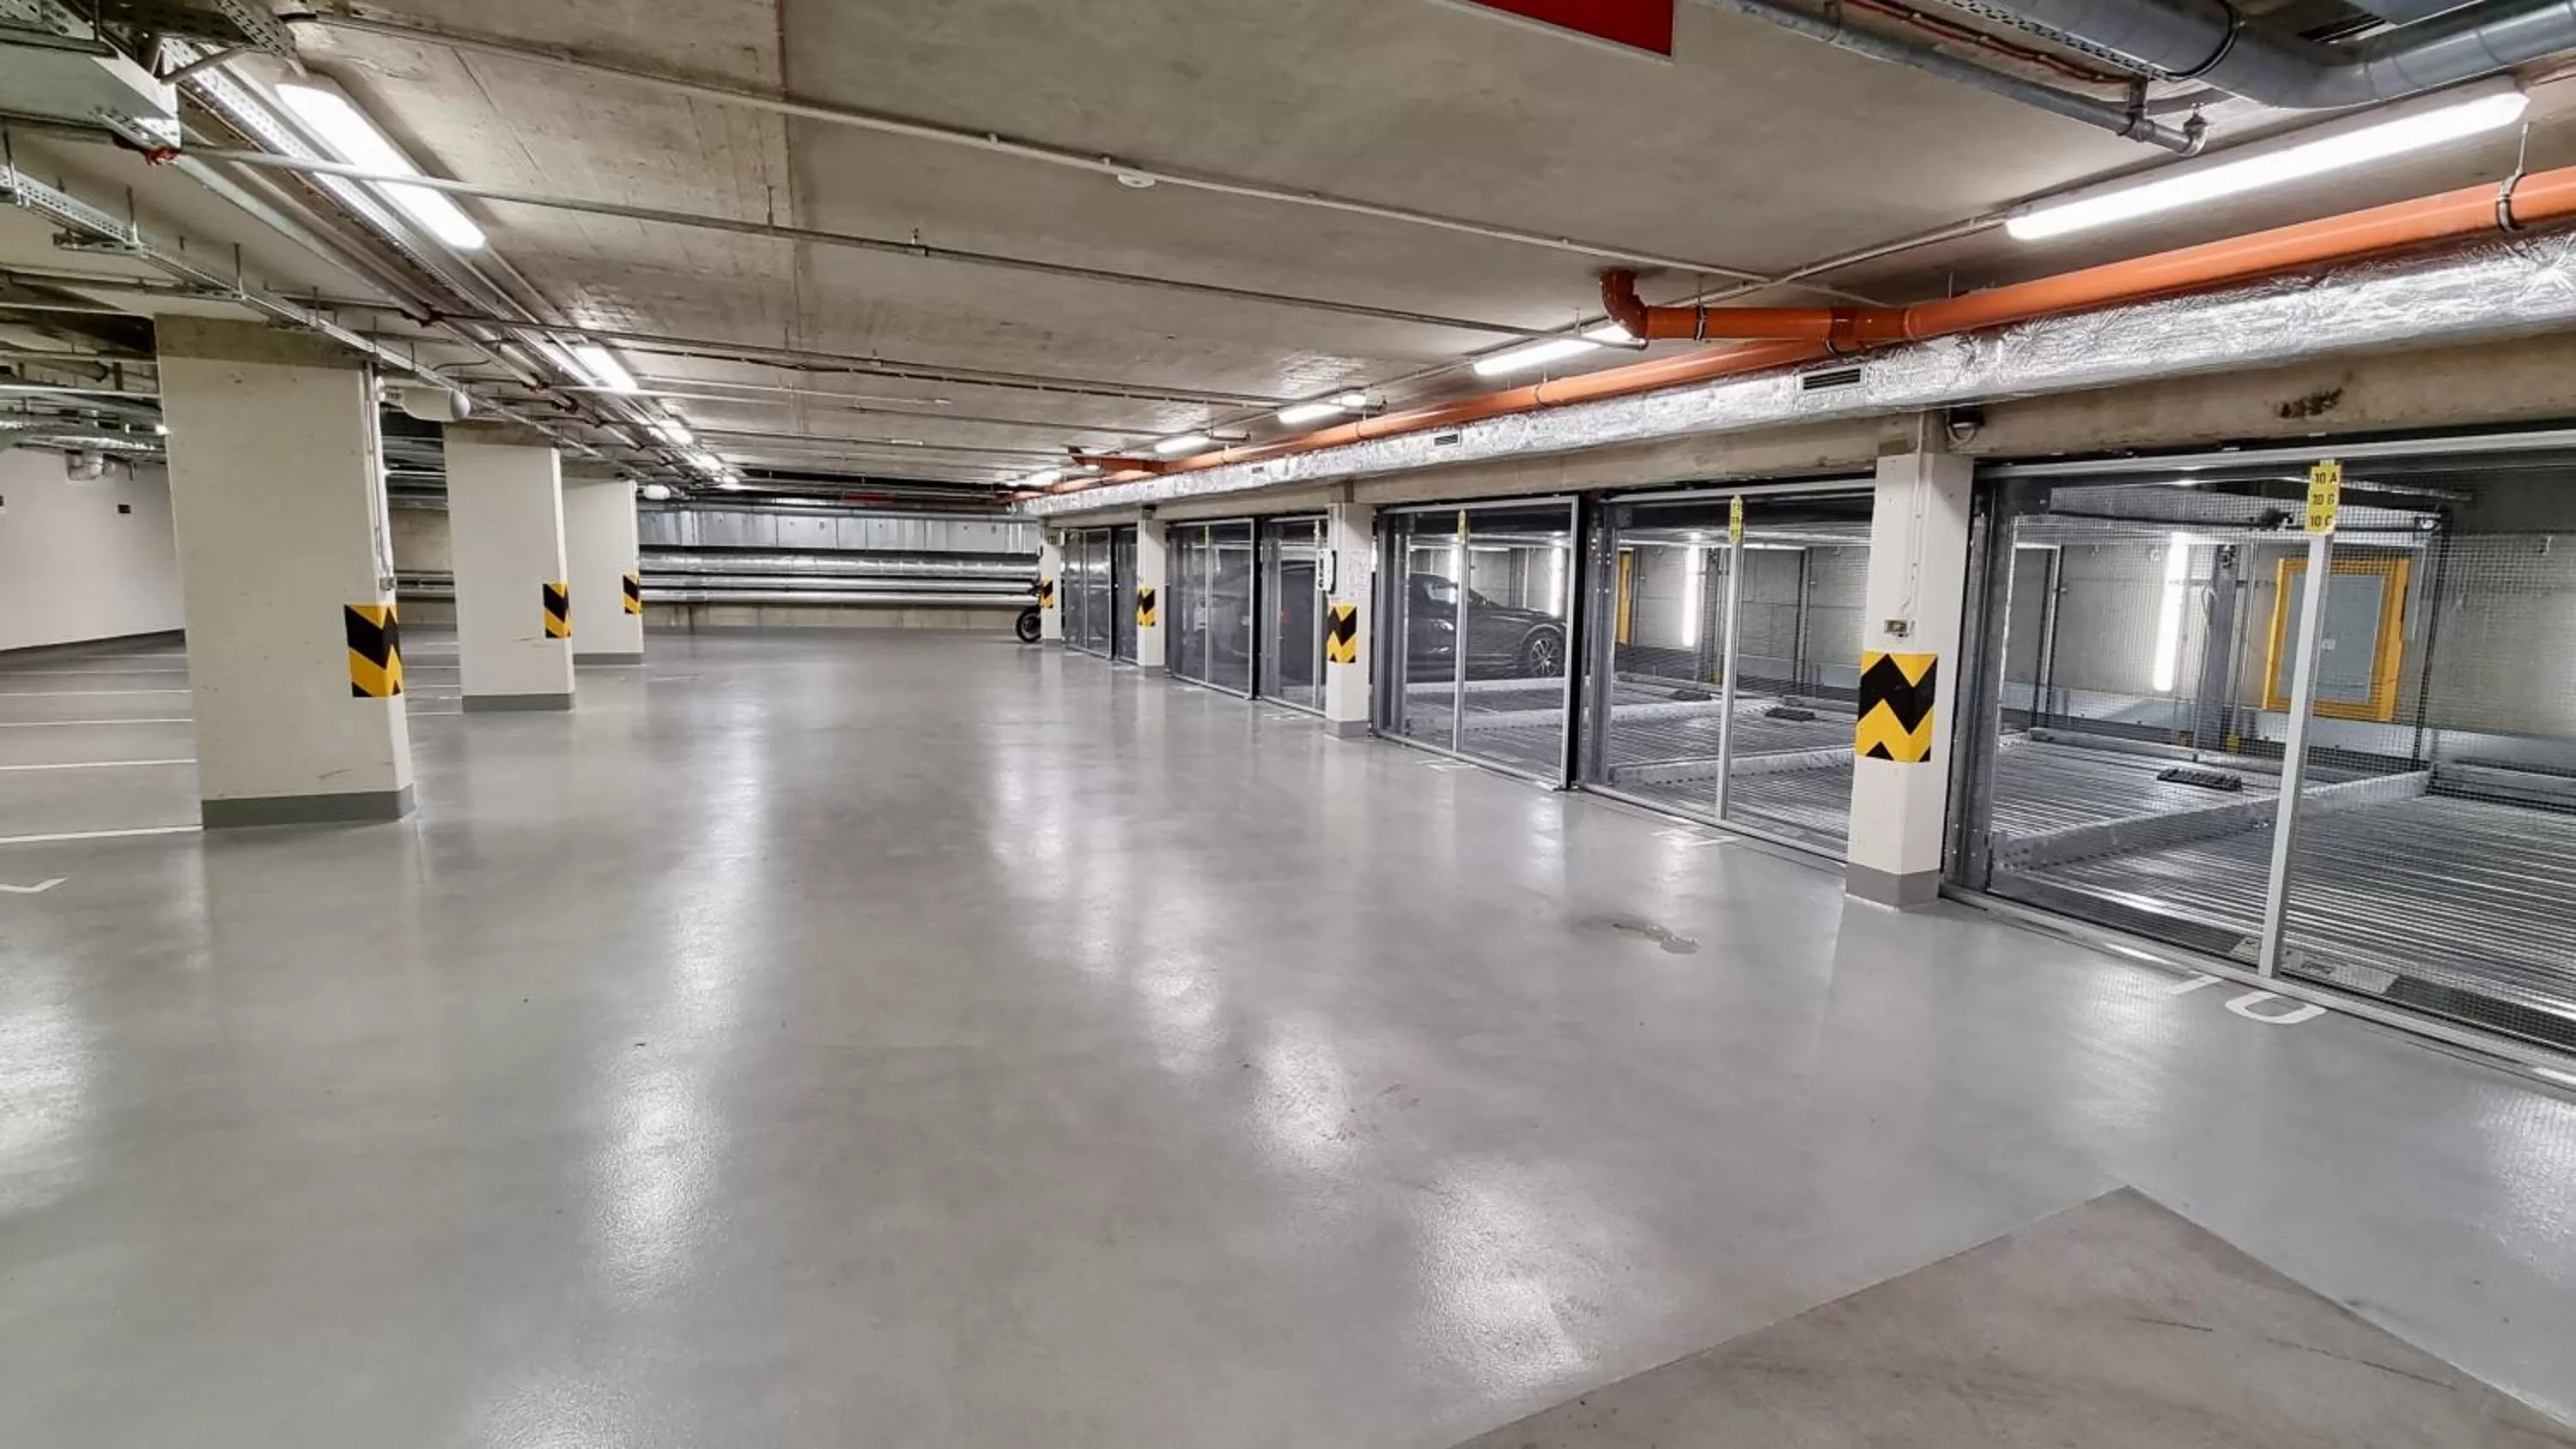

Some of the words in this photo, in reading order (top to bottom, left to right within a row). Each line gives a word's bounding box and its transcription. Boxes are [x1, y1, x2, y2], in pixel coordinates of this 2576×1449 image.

[2315, 472, 2326, 484] 10
[2329, 472, 2337, 482] A
[2310, 515, 2322, 527] 10
